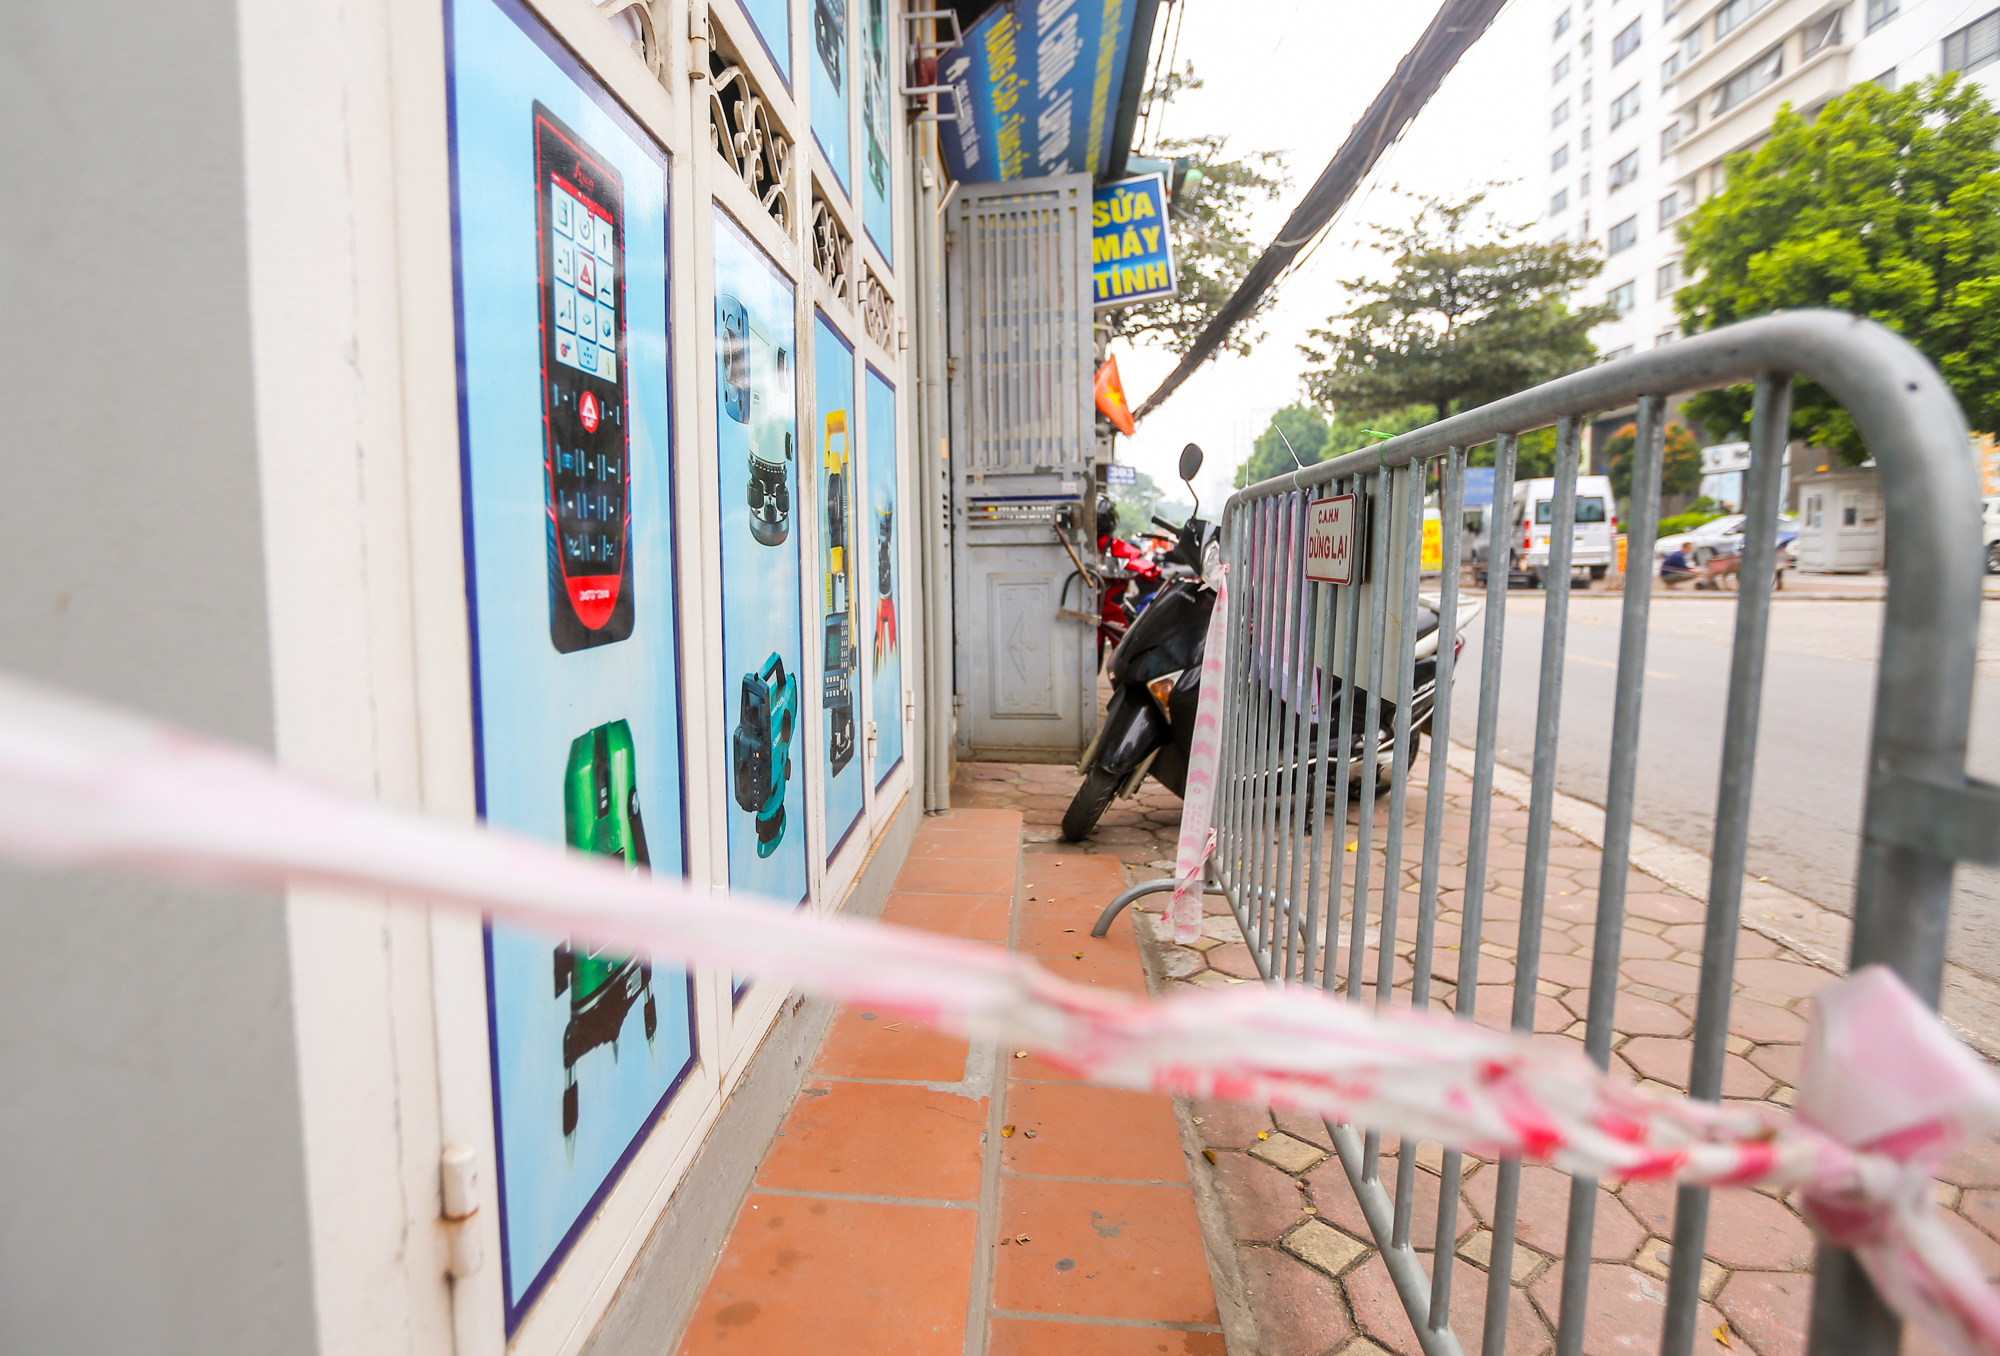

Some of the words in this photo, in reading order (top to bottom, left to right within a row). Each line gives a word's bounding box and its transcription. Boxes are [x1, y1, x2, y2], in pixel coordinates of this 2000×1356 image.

[1037, 87, 1073, 168] LAPTOP
[1093, 188, 1156, 228] SỬA
[1093, 225, 1161, 264] MÁY
[1093, 263, 1169, 299] TÍNH
[1308, 528, 1330, 559] DỪNG
[1331, 535, 1348, 566] LẠI
